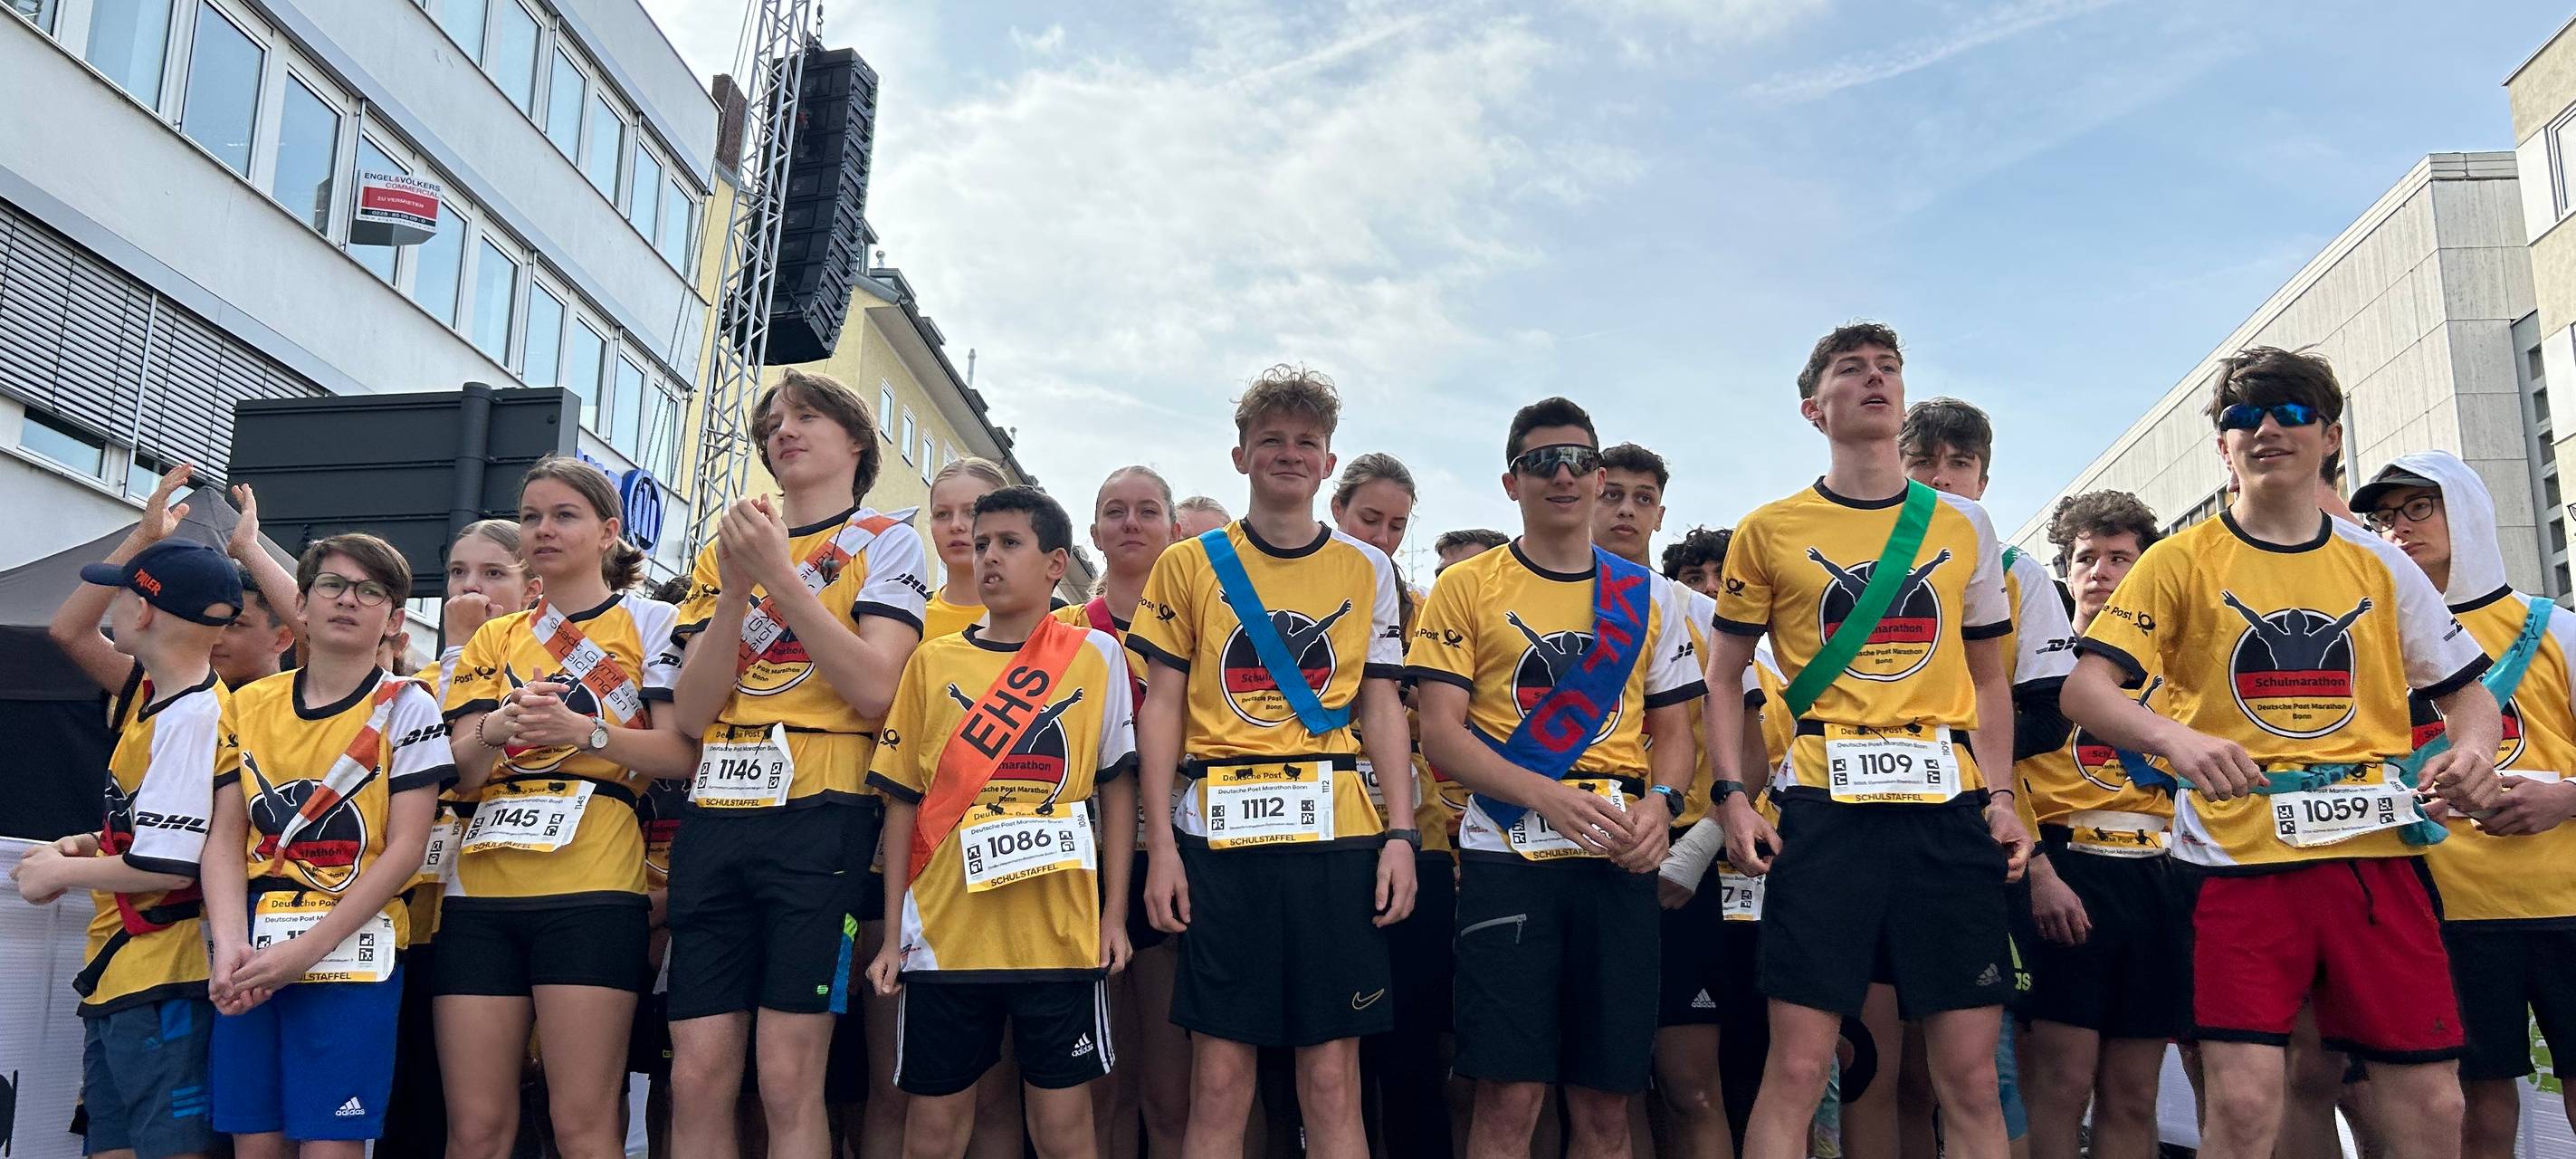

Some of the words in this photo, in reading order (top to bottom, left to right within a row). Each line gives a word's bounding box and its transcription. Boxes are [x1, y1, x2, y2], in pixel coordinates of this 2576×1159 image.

[385, 182, 439, 197] COMMERCIAL
[386, 196, 425, 209] VERMIETEN
[2111, 607, 2132, 620] Post
[550, 618, 583, 651] Stadt
[1419, 627, 1439, 641] Post
[454, 675, 472, 685] Post
[559, 646, 627, 711] Leichlingen
[751, 673, 769, 682] Bonn
[2256, 677, 2345, 687] Schulmarathon
[960, 666, 1050, 760] EHS
[1884, 725, 1903, 734] Post
[1942, 741, 1951, 756] 1109
[719, 759, 762, 780] 1146
[1858, 752, 1913, 774] 1109
[1263, 771, 1282, 781] Post
[1017, 785, 1049, 794] Marathon
[1856, 792, 1923, 801] SCHULSTAFFEL
[575, 795, 587, 810] 1145
[706, 798, 759, 807] SCHULSTAFFEL
[1242, 797, 1284, 819] 1112
[2302, 797, 2369, 822] 1059
[136, 810, 210, 834] DHL
[491, 809, 540, 828] 1145
[970, 820, 1000, 835] Deutsche
[988, 829, 1051, 857] 1086
[1230, 834, 1296, 846] SCHULSTAFFEL
[991, 864, 1058, 886] SCHULSTAFFEL
[1072, 1043, 1093, 1057] adidas
